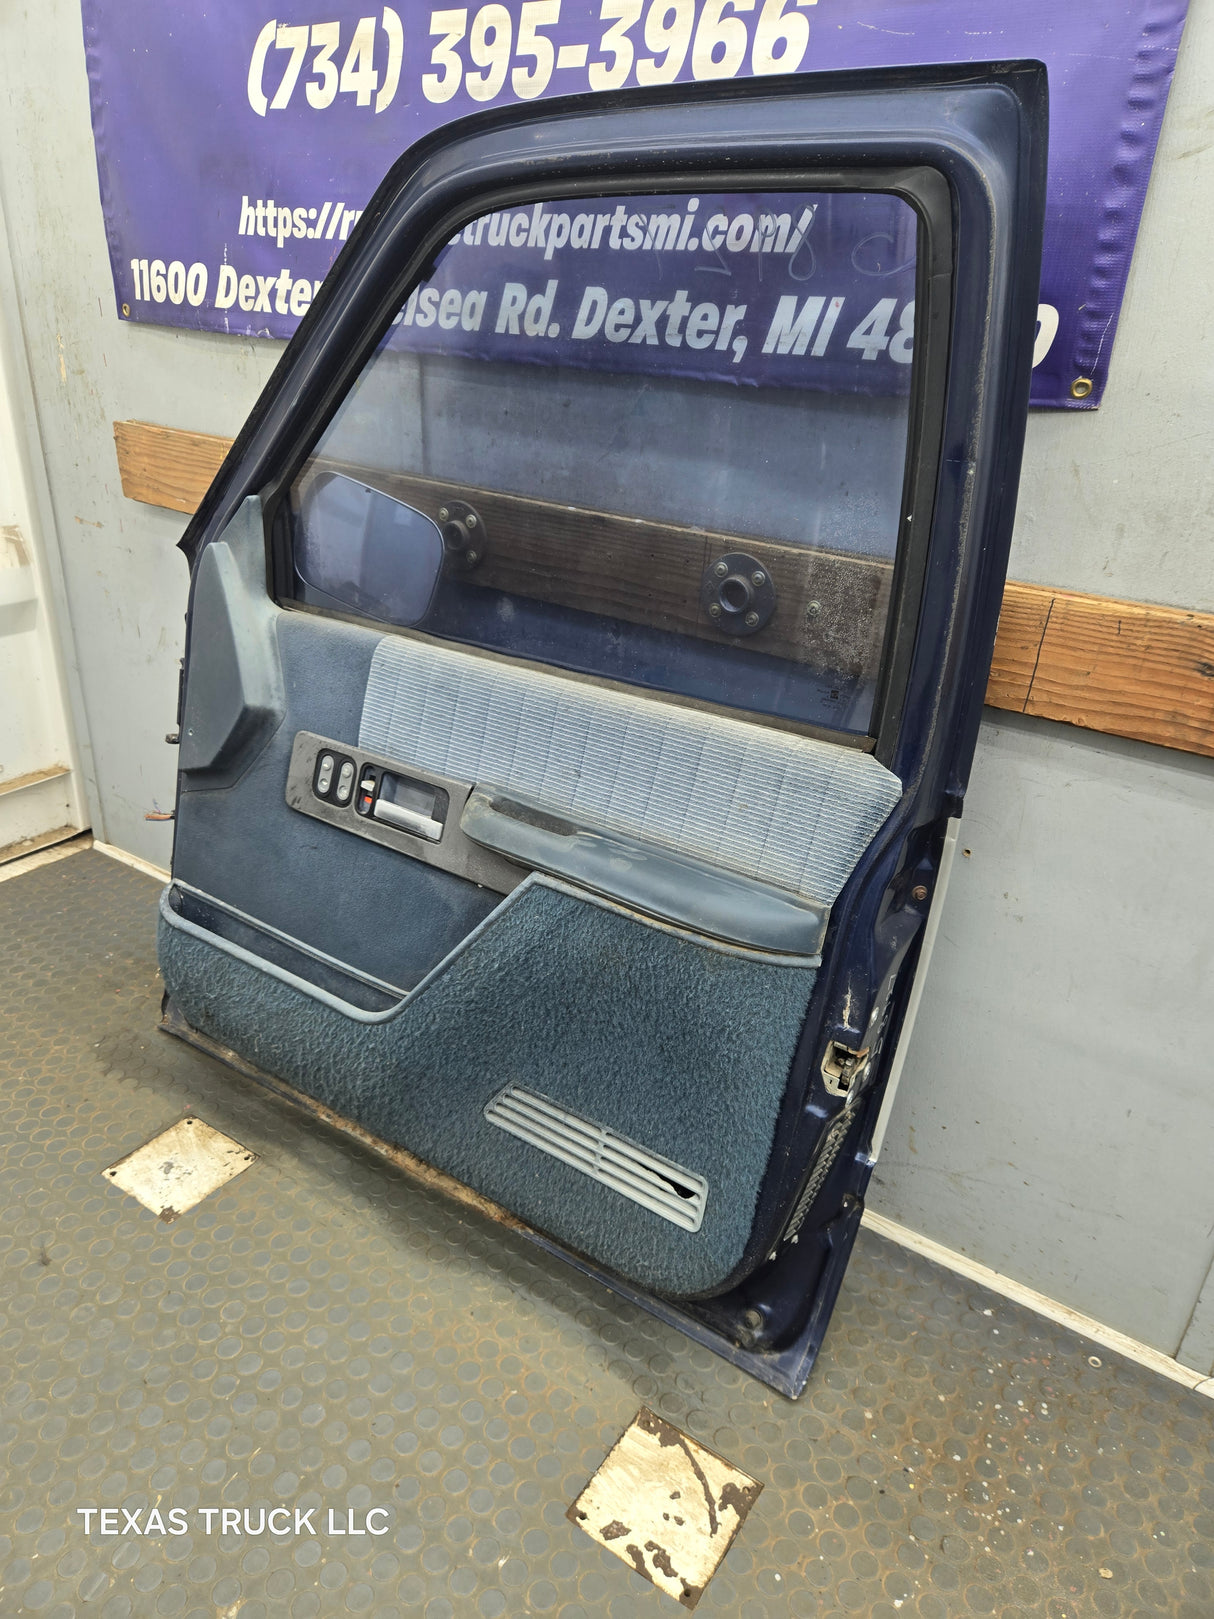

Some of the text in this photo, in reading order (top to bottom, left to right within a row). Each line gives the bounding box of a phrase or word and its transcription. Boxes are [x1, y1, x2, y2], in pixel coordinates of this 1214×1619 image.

[247, 0, 818, 117] (734) 395-3966
[238, 195, 363, 248] https://r
[130, 258, 208, 307] 11600
[392, 283, 488, 332] lsea
[495, 279, 561, 338] Rd.
[571, 286, 748, 363] Dexter,
[761, 296, 845, 356] MI
